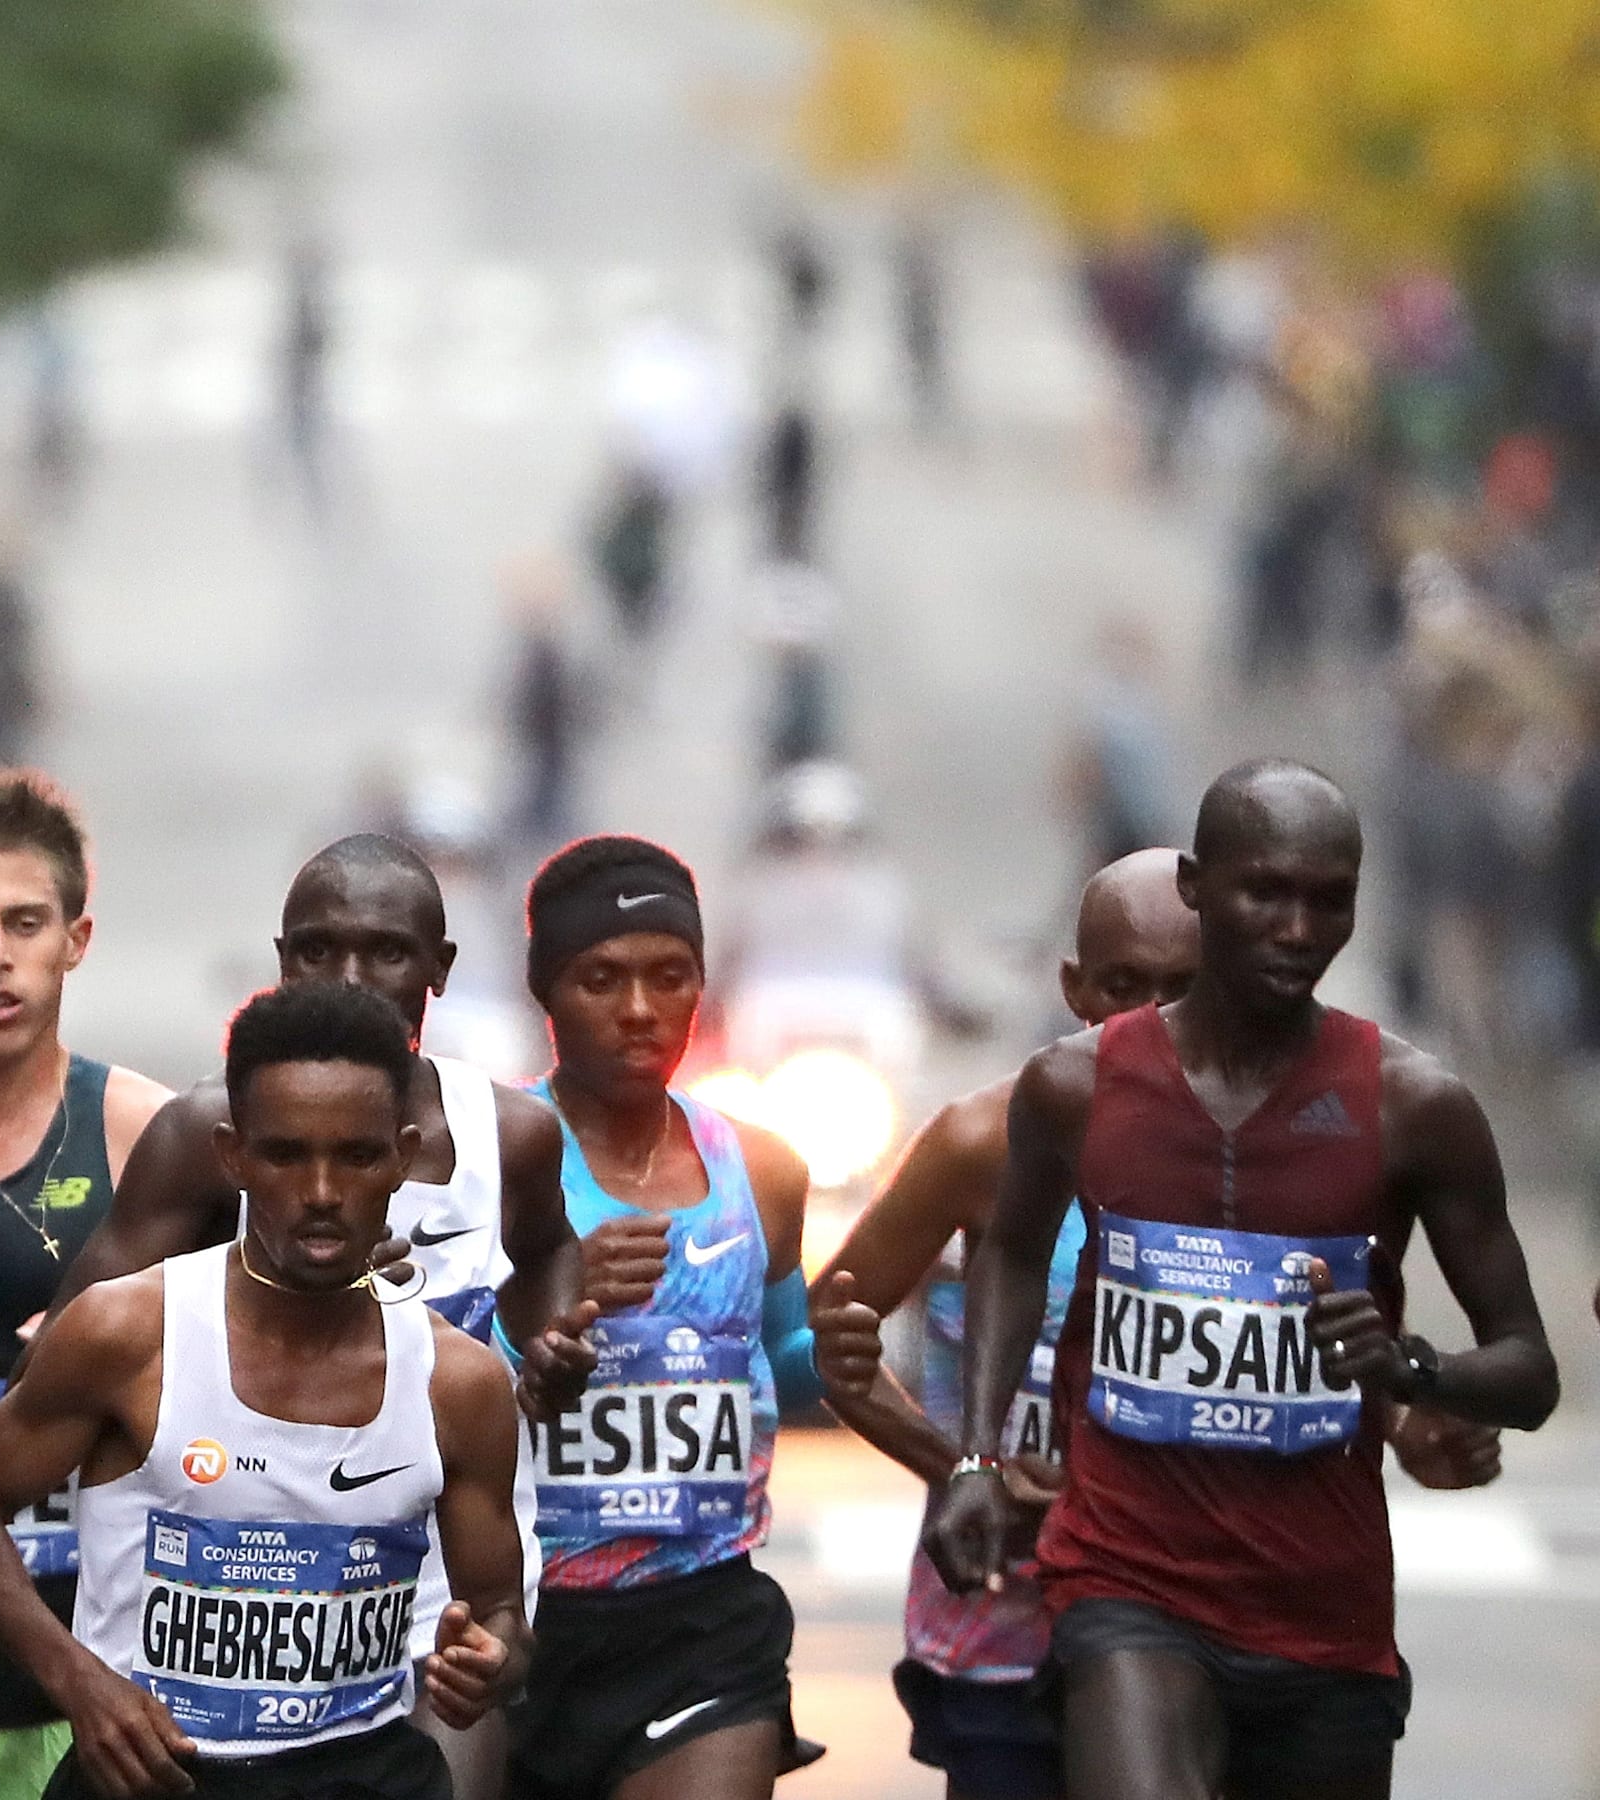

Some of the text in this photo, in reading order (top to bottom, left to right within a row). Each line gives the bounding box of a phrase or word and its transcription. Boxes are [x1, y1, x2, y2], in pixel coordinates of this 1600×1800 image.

[1175, 1235, 1224, 1254] TATA
[1140, 1249, 1254, 1275] CONSULTANCY
[1158, 1268, 1232, 1290] SERVICES
[1100, 1288, 1352, 1393] KIPSAN
[662, 1355, 707, 1371] TATA
[1192, 1401, 1274, 1432] 2017
[528, 1393, 742, 1475] ESISA
[236, 1456, 267, 1472] NN
[600, 1487, 681, 1517] 2017
[158, 1540, 185, 1556] RUN
[238, 1531, 287, 1546] TATA
[202, 1546, 319, 1565] CONSULTANCY
[221, 1564, 297, 1582] SERVICES
[341, 1562, 382, 1580] TATA
[256, 1694, 333, 1725] 2017
